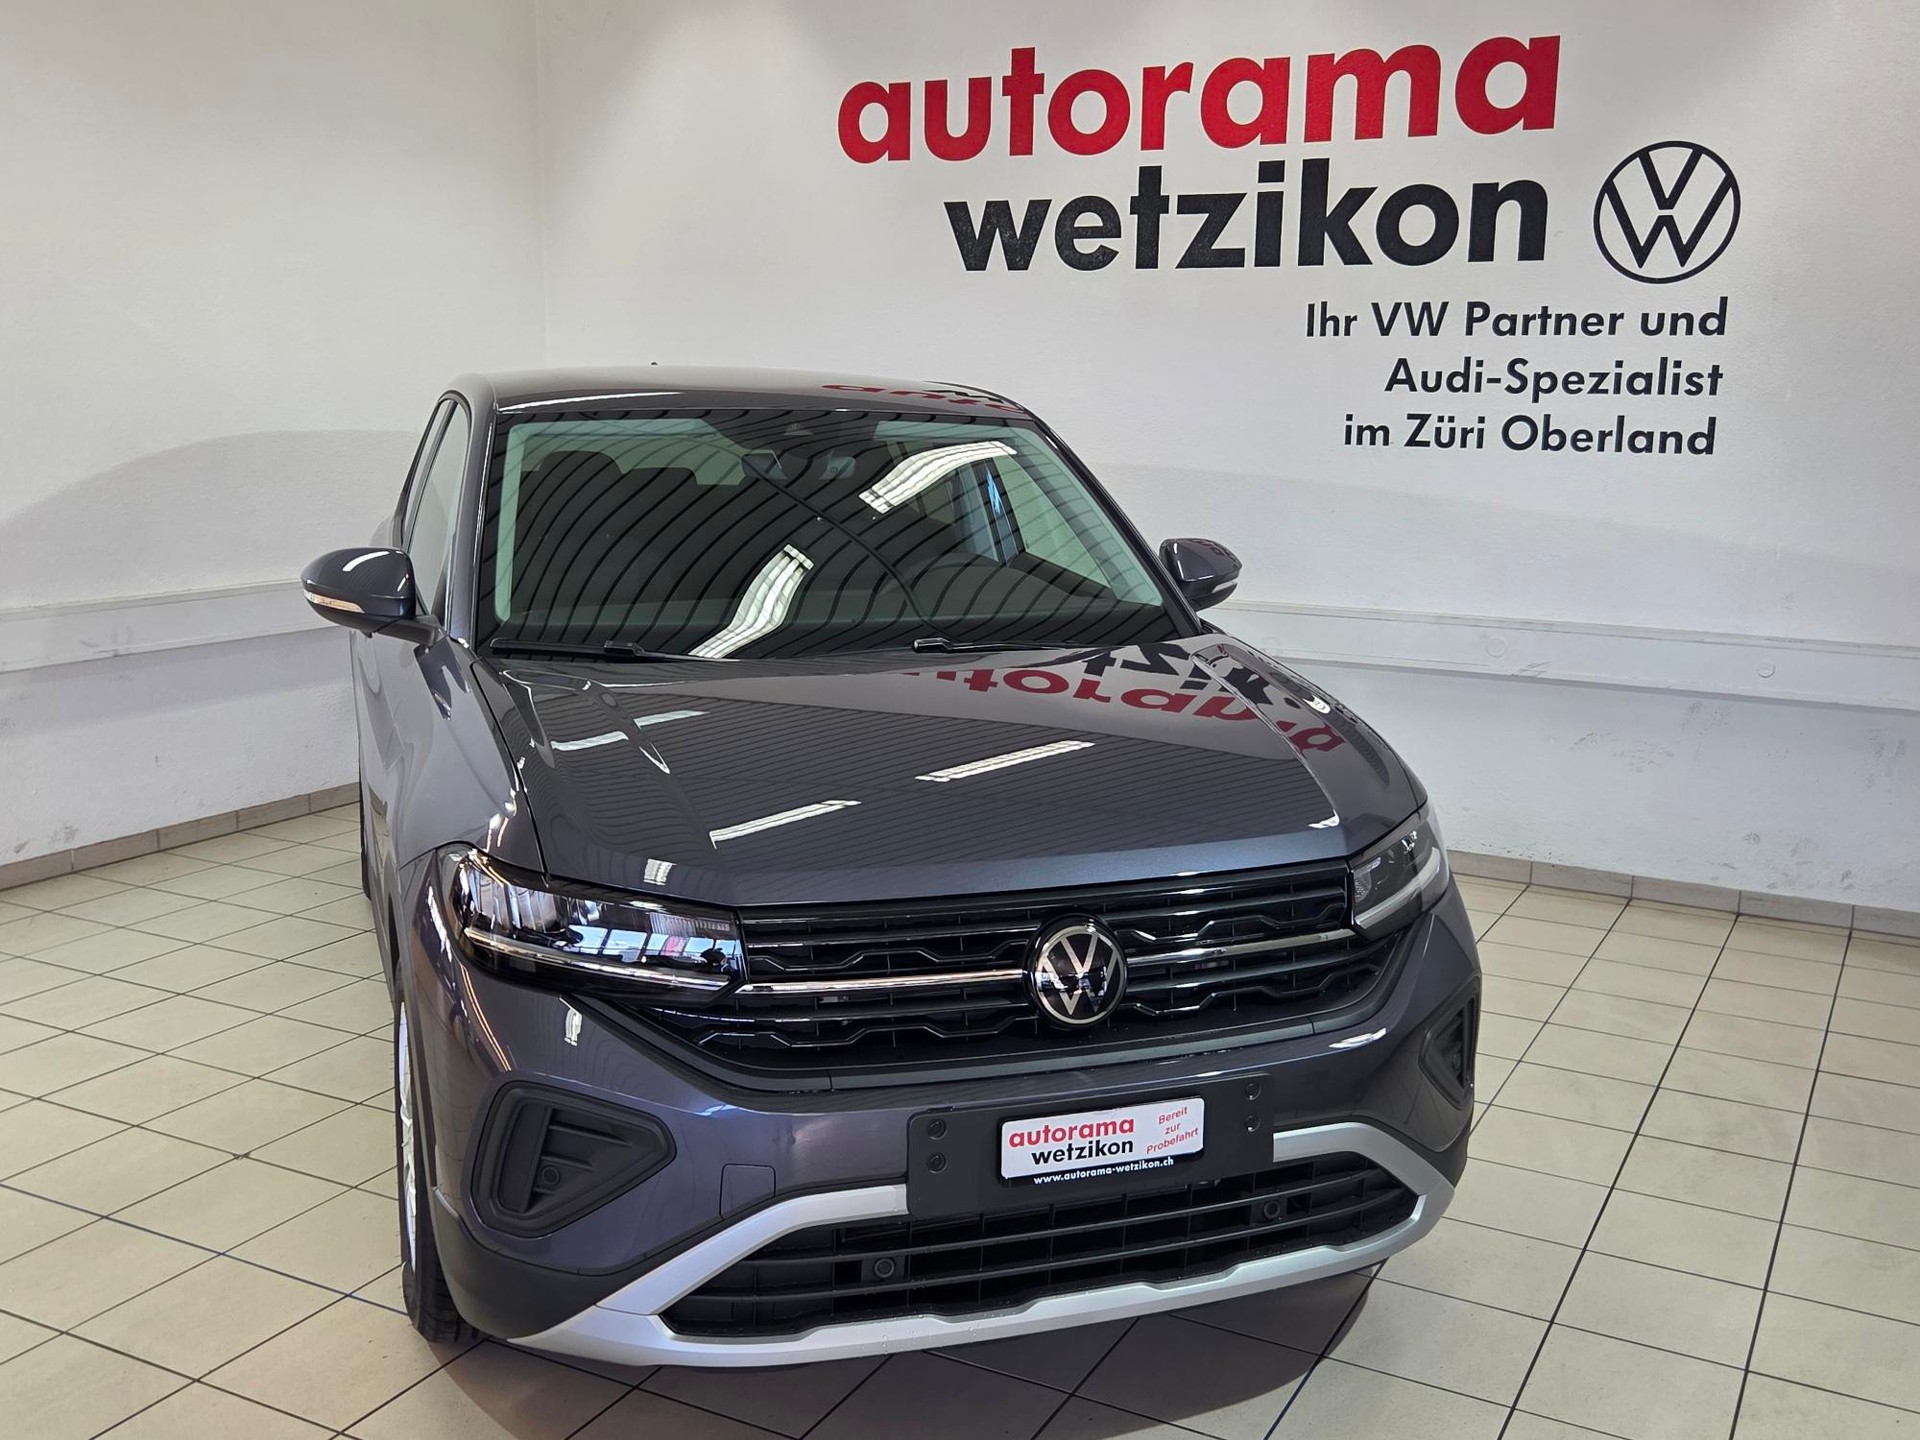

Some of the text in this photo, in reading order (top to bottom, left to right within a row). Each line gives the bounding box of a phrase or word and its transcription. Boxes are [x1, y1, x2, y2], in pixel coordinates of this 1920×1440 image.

[837, 35, 1561, 165] autorama
[943, 157, 1549, 275] wetzikon
[1306, 296, 1729, 337] Ihr VW Partner und
[1384, 356, 1724, 404] Audi-Spezialist
[1344, 413, 1717, 455] im Züri Oberland
[1158, 1106, 1188, 1124] Bereit
[1165, 1123, 1181, 1135] zur
[1008, 1118, 1135, 1147] autorama
[1146, 1127, 1199, 1154] Probefahrt
[1031, 1139, 1134, 1165] wetzikon
[1034, 1155, 1174, 1185] www.autorama-wetzikon.ch
